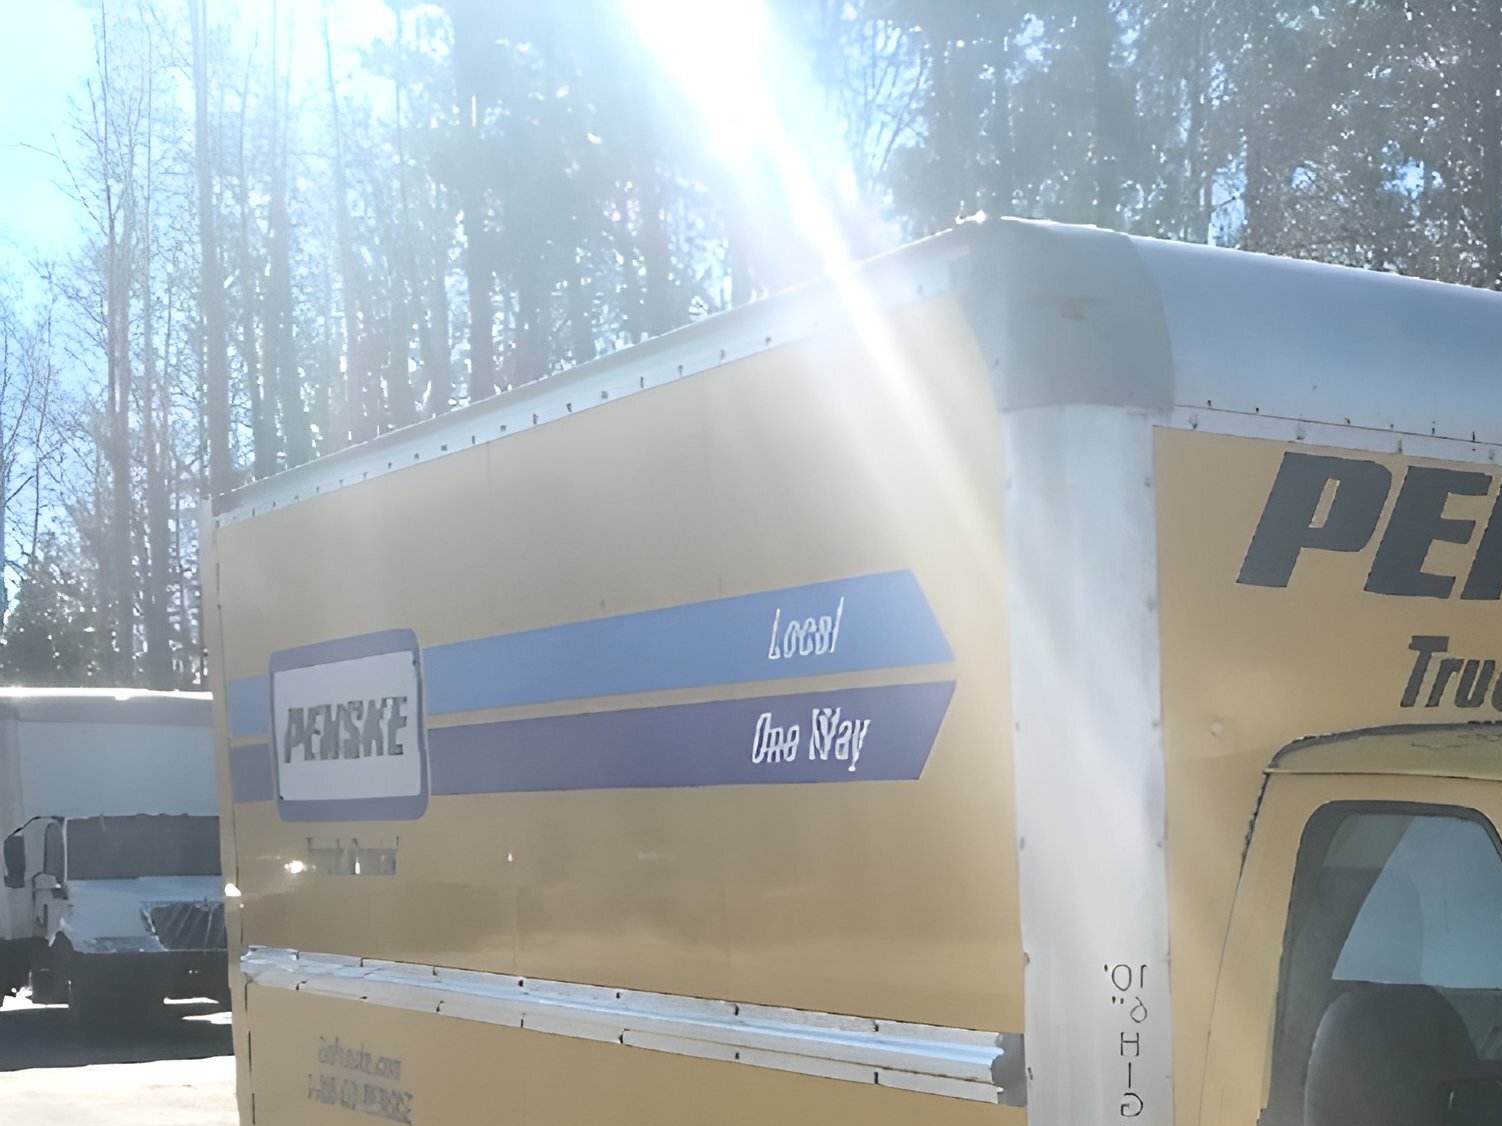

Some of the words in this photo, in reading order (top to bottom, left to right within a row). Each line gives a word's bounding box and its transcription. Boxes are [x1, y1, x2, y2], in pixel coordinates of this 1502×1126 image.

[768, 596, 844, 660] Local
[284, 696, 407, 763] PENSKE
[752, 712, 799, 764] One
